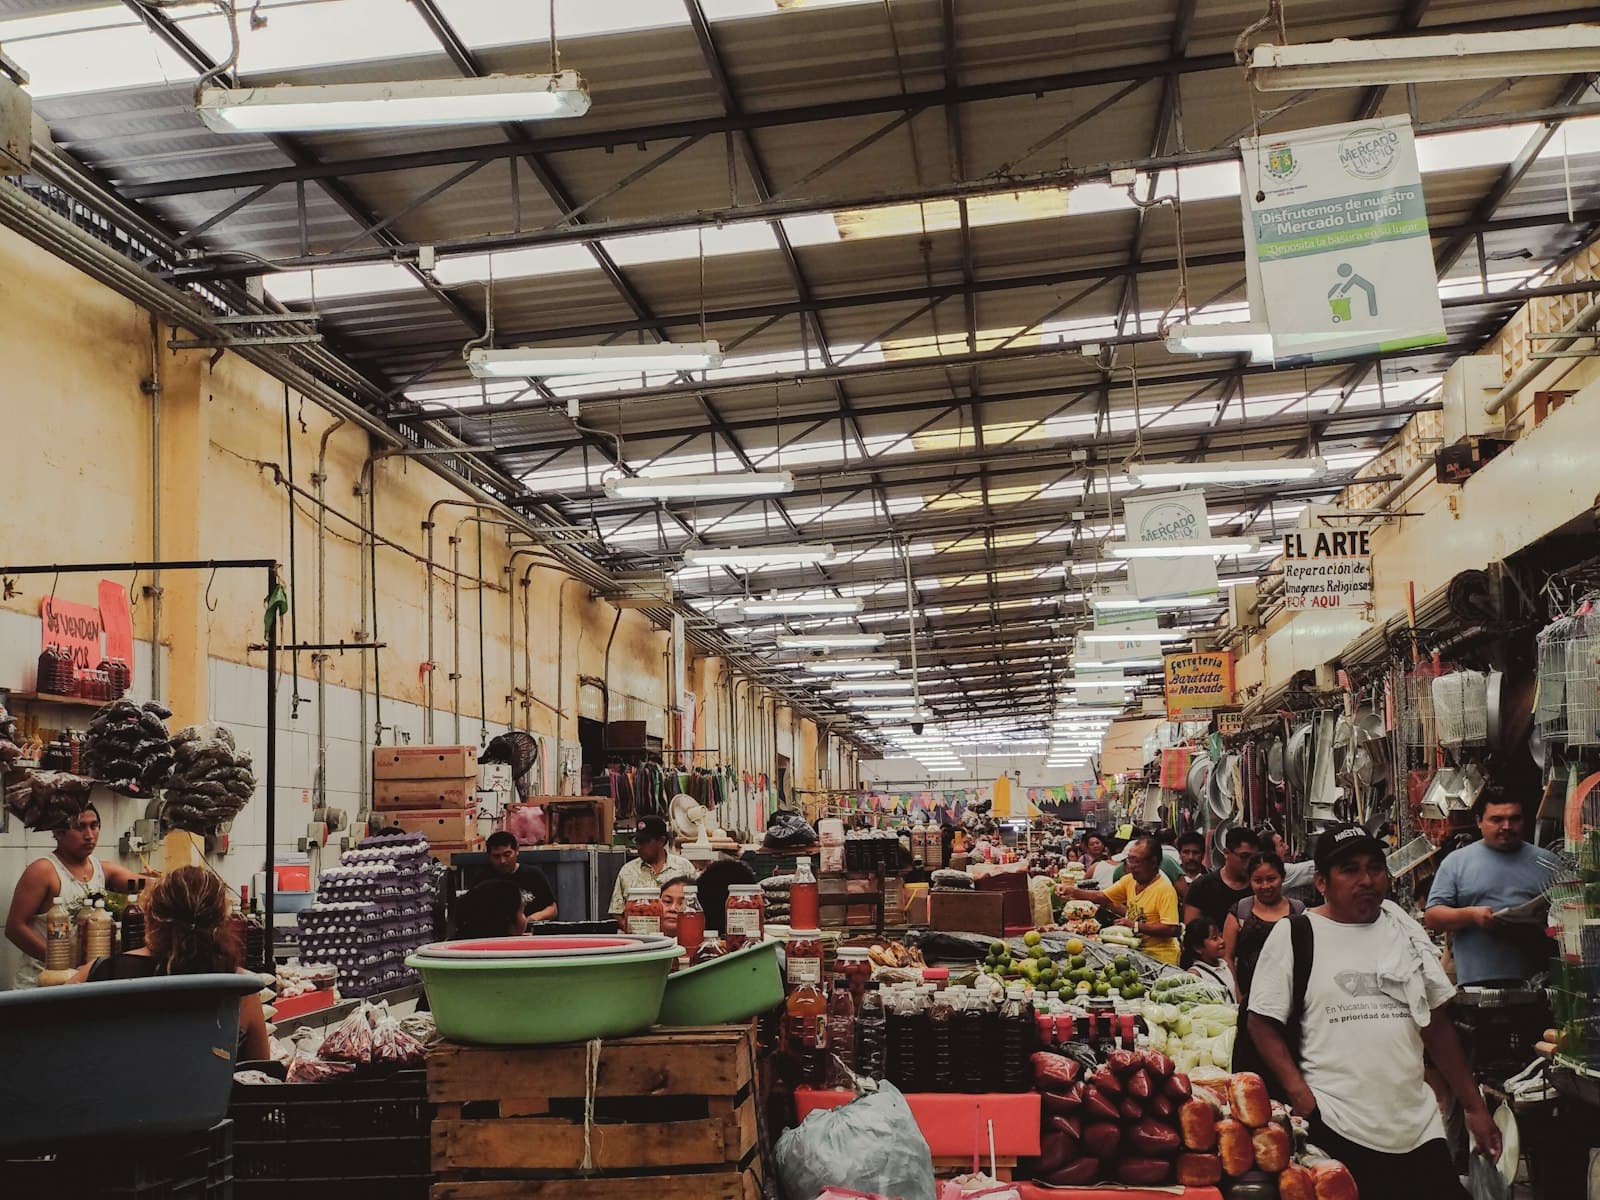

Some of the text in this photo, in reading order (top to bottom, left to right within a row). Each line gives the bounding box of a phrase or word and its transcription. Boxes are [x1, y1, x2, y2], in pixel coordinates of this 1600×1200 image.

[1340, 132, 1397, 164] MERCADO
[1345, 199, 1361, 210] de
[1364, 190, 1415, 208] nuestro
[1277, 202, 1402, 236] Mercado Limpio!
[1141, 513, 1196, 544] MERCADO
[1285, 531, 1370, 558] EL ARTE
[1286, 561, 1351, 580] Reparación
[1287, 595, 1340, 608] POR AQUI
[1178, 682, 1224, 695] Mercado
[1325, 1006, 1336, 1015] En
[1341, 1012, 1379, 1023] prioridad
